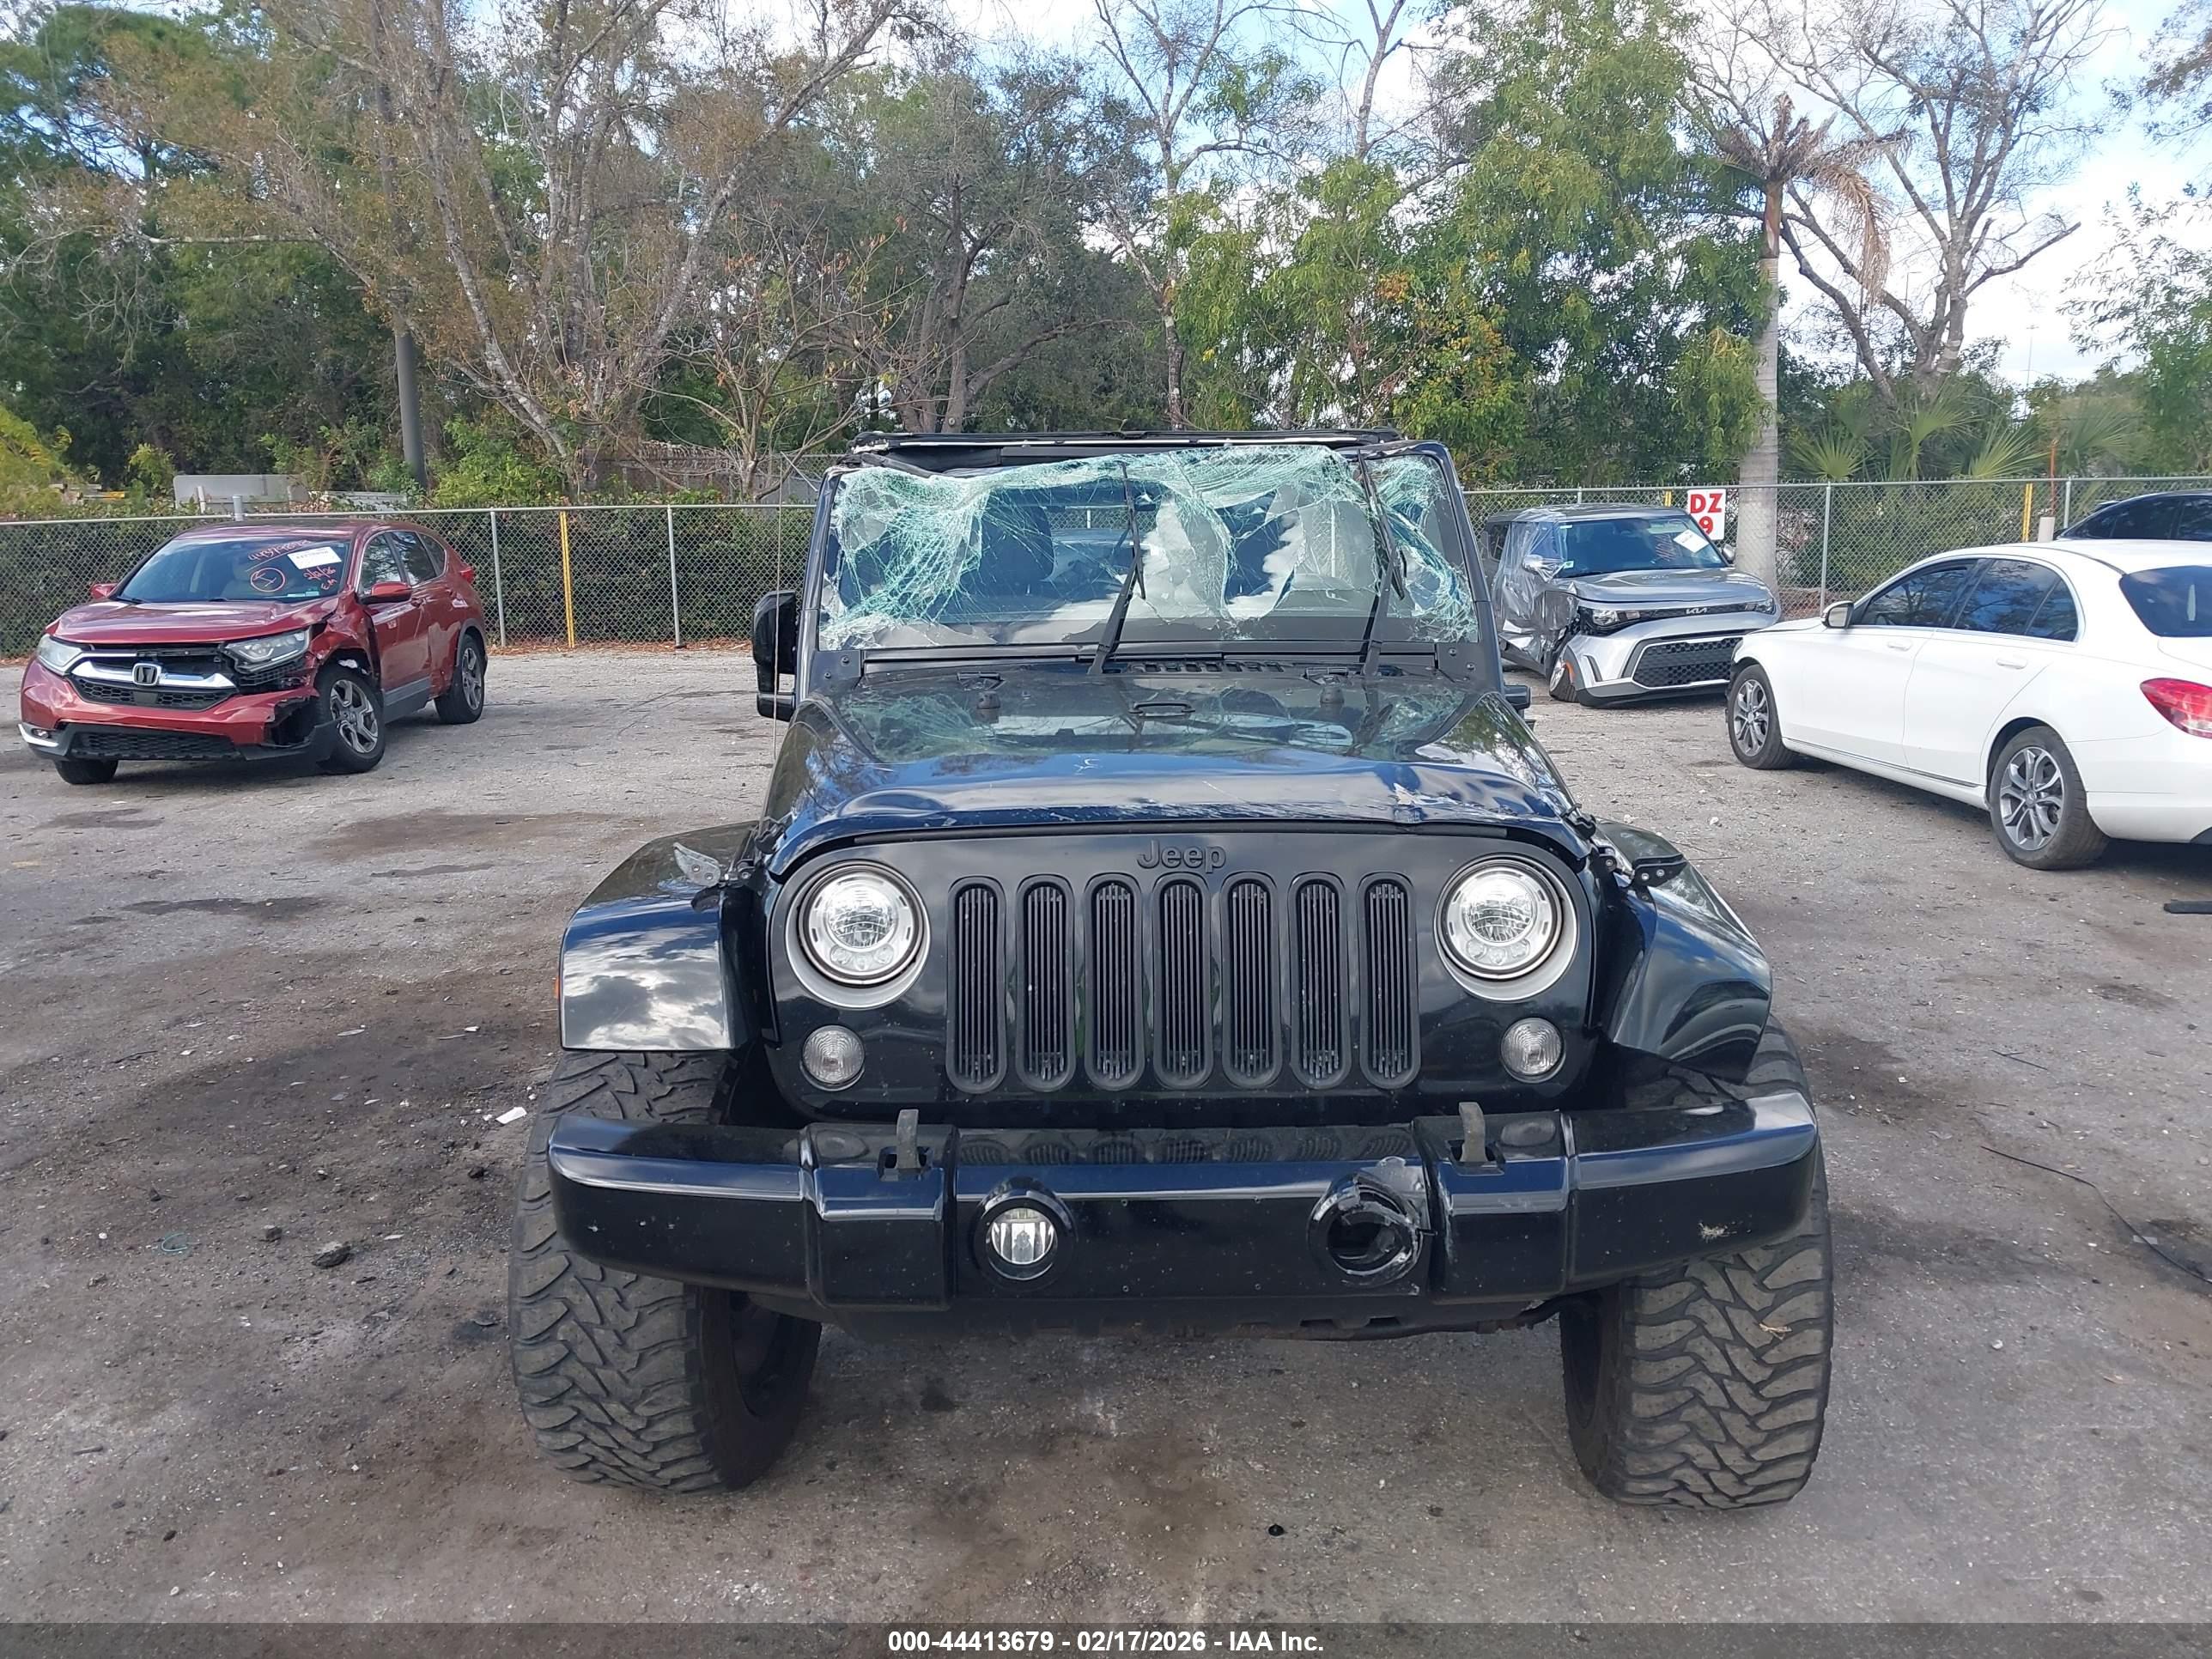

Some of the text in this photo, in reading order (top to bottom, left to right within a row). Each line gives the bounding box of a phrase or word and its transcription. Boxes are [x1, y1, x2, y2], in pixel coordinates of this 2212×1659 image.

[1690, 493, 1723, 514] DZ
[1698, 515, 1714, 536] 9
[1137, 840, 1226, 874] Jeep
